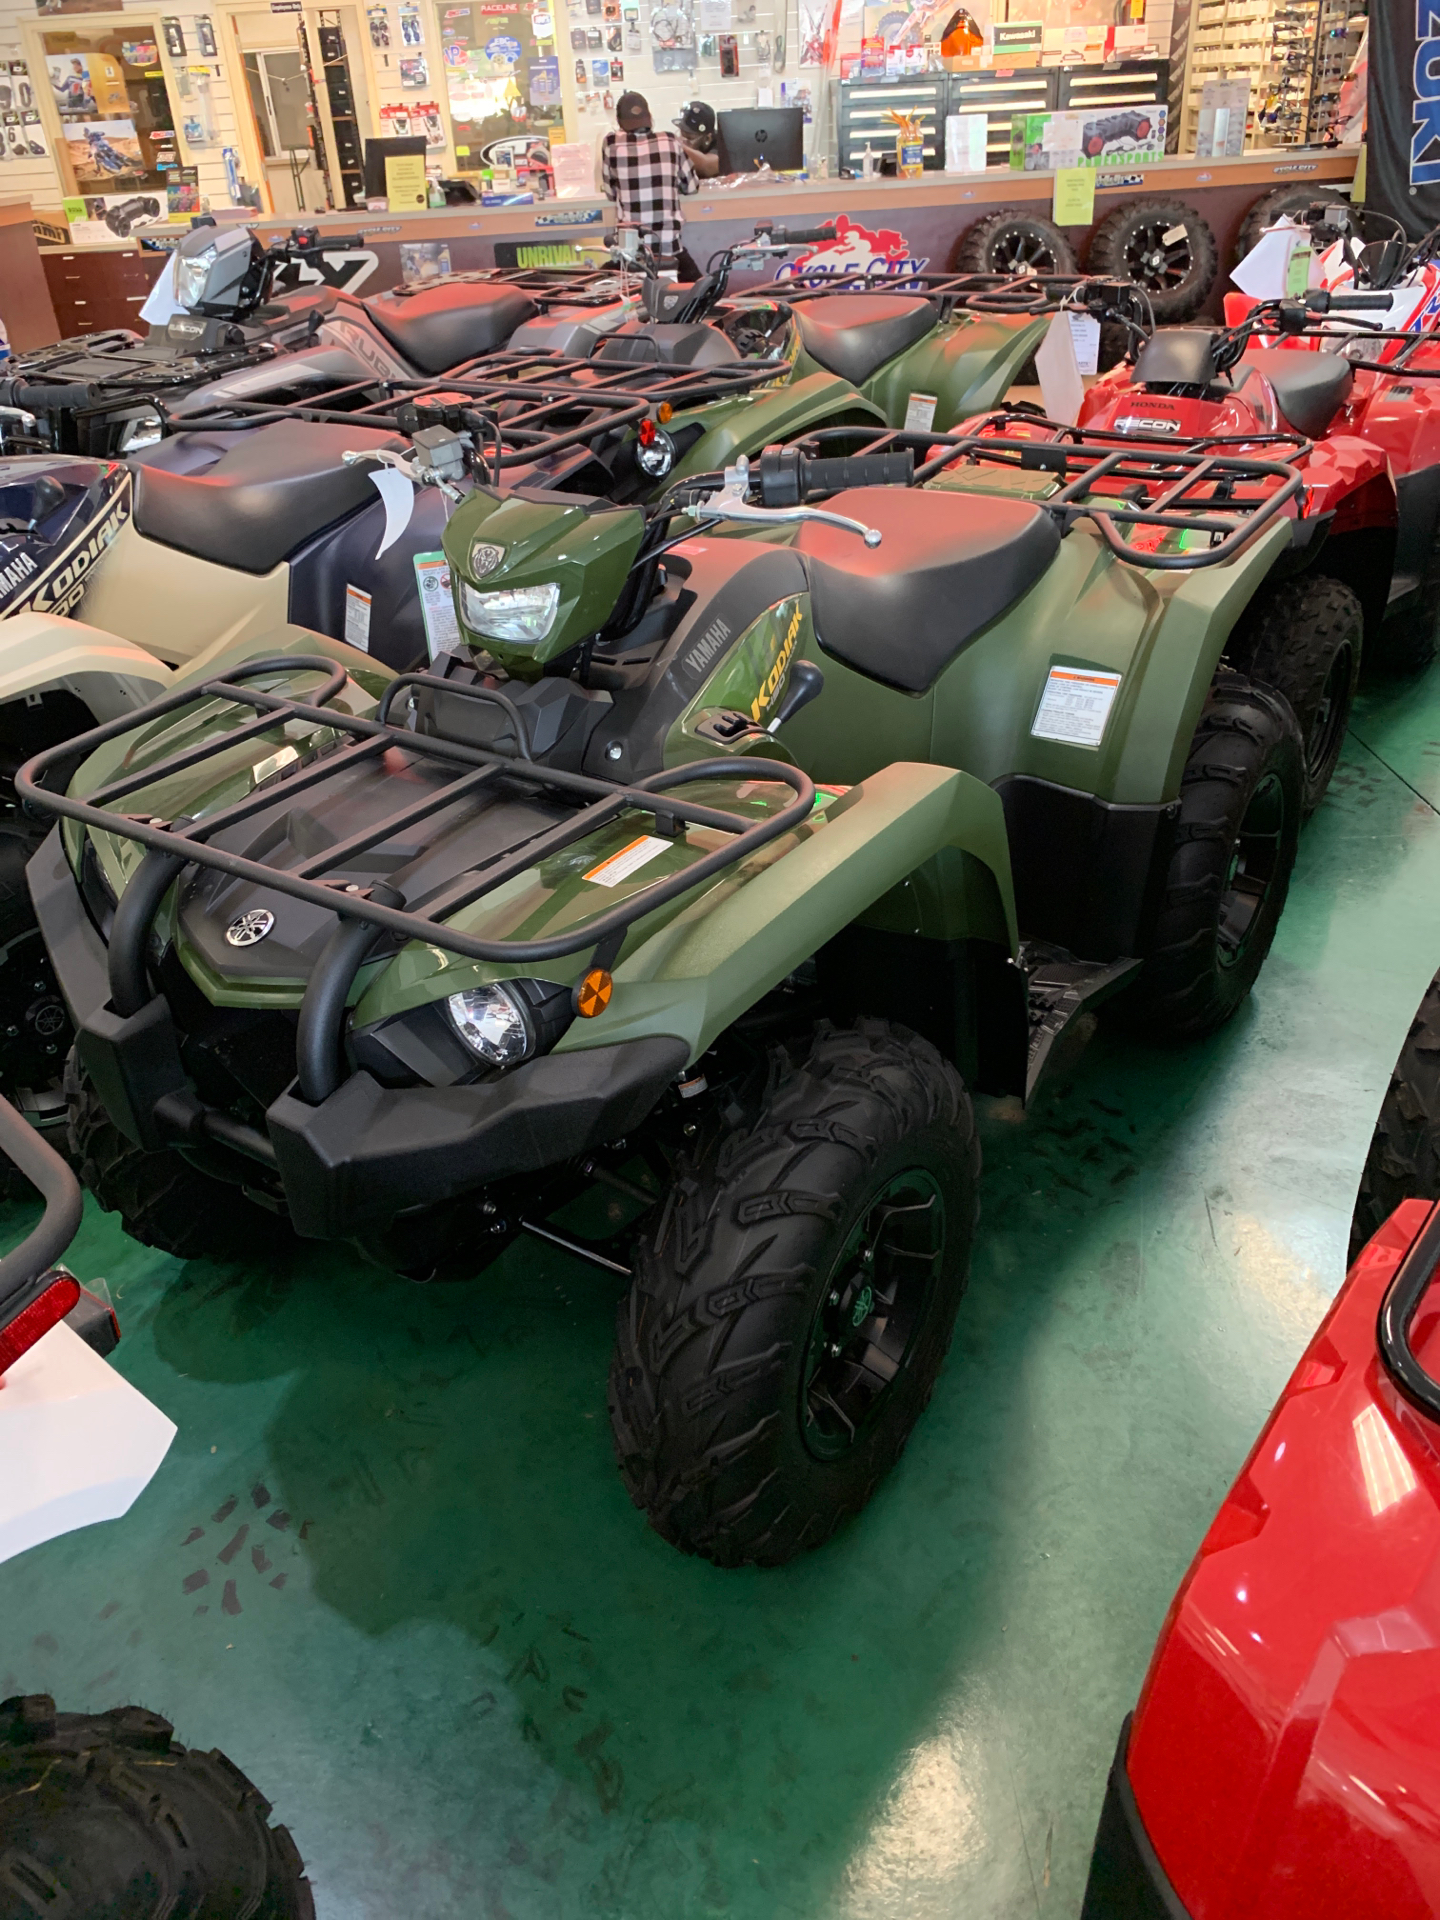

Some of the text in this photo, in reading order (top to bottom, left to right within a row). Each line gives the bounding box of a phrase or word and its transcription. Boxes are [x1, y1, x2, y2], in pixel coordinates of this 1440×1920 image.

[999, 29, 1036, 41] Kawasaki
[1077, 151, 1165, 168] POWERSPORTS
[1130, 401, 1175, 411] HONDA
[1114, 419, 1181, 431] RECON
[20, 501, 127, 614] KODIAK
[0, 552, 38, 599] MAHA
[686, 618, 731, 673] YAMAHA
[751, 602, 803, 722] KODIAK
